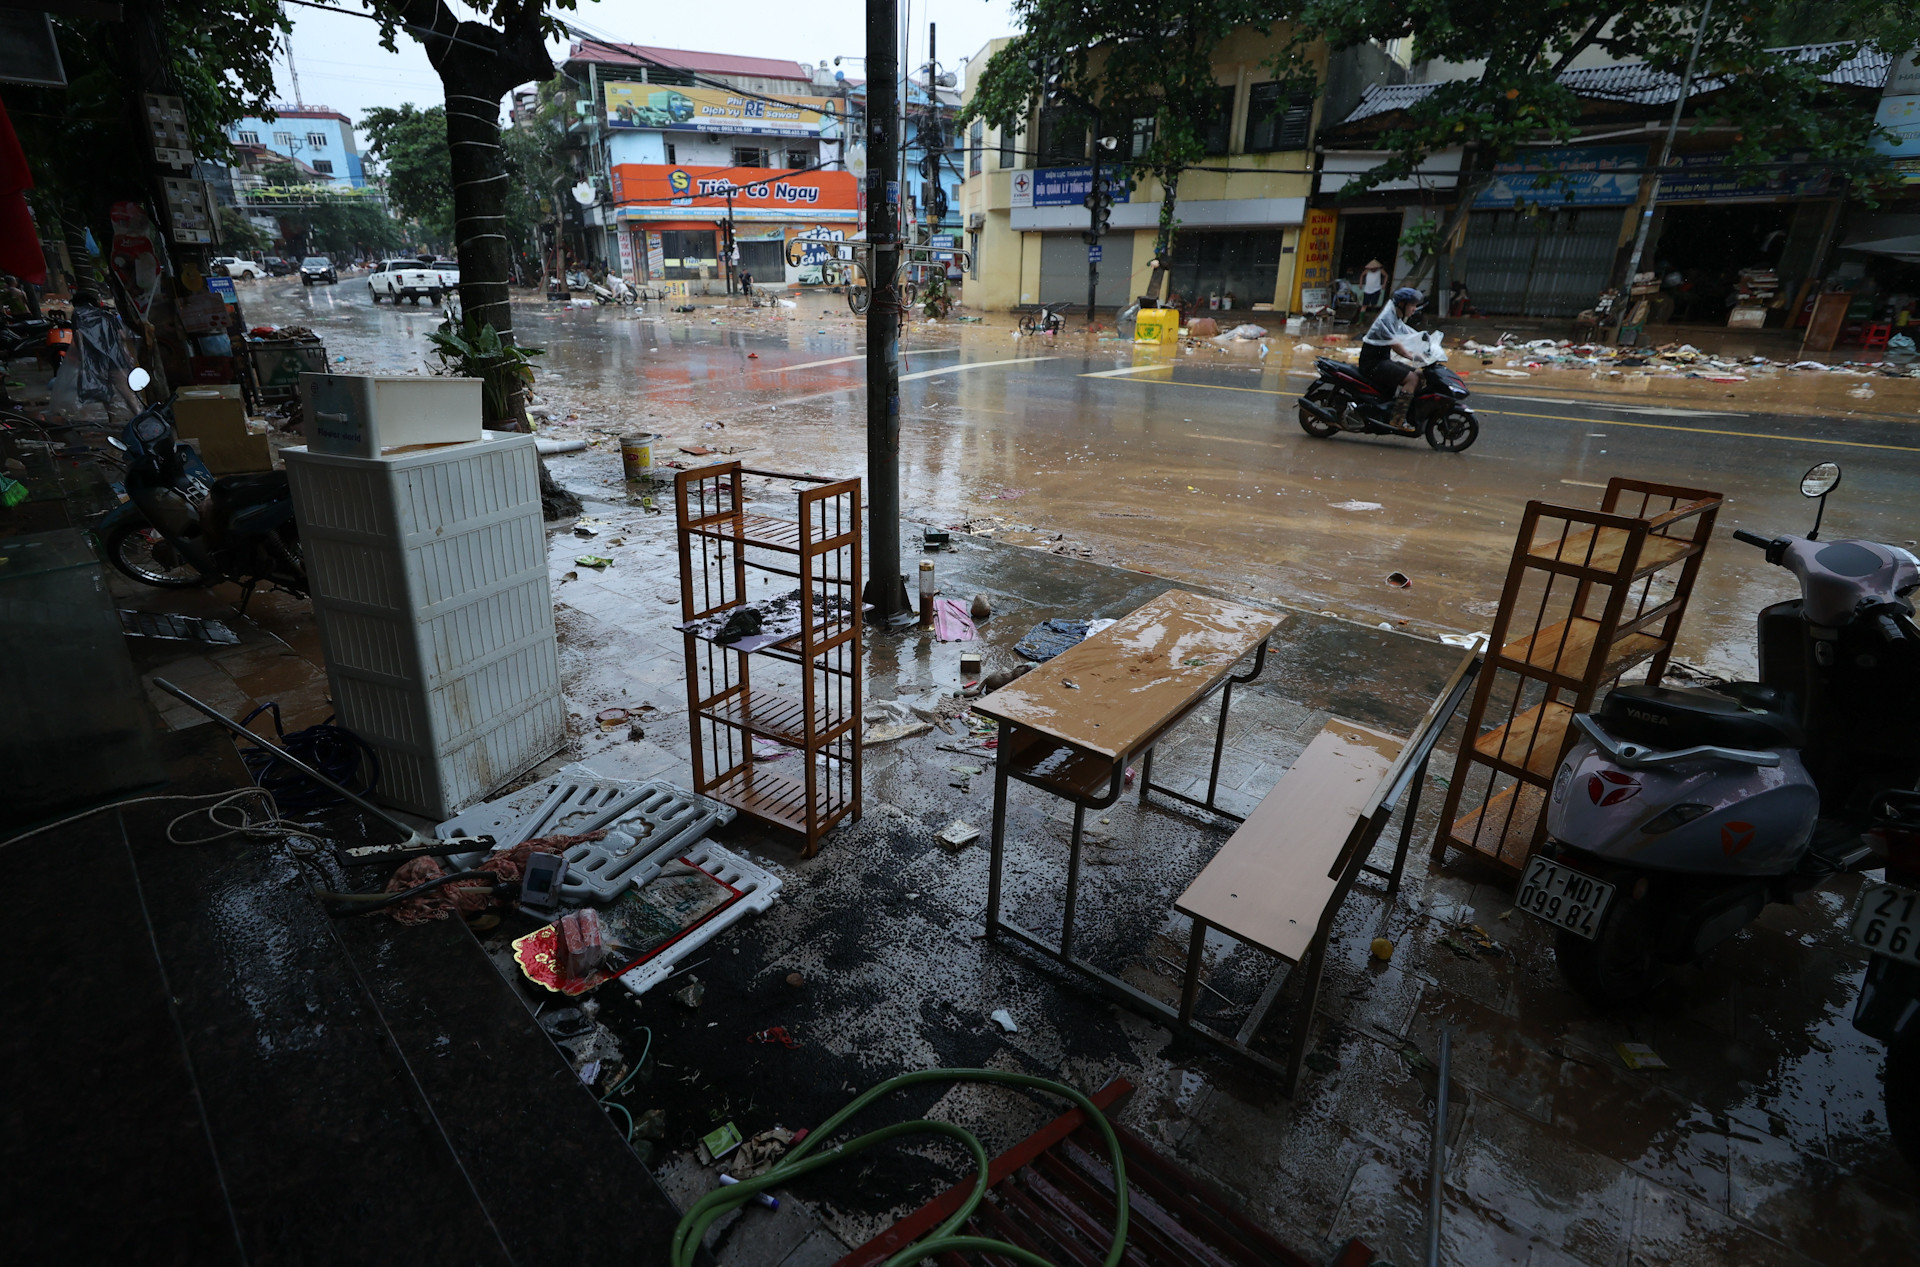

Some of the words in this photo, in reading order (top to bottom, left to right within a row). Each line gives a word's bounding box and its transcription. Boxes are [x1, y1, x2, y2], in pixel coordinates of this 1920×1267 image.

[702, 106, 726, 117] Dịch
[766, 110, 800, 122] Sawad
[697, 178, 739, 198] Tiền
[745, 182, 770, 198] Có
[776, 182, 820, 202] Ngay
[1036, 183, 1046, 196] ĐỘI
[1047, 181, 1061, 195] QUẢN
[1062, 180, 1069, 194] LÝ
[1070, 178, 1083, 194] TỔNG
[801, 253, 815, 266] Có
[1626, 707, 1669, 726] YADEA
[1529, 861, 1605, 909] 21-MD1
[1520, 885, 1594, 935] 099.84
[1864, 918, 1920, 960] 66
